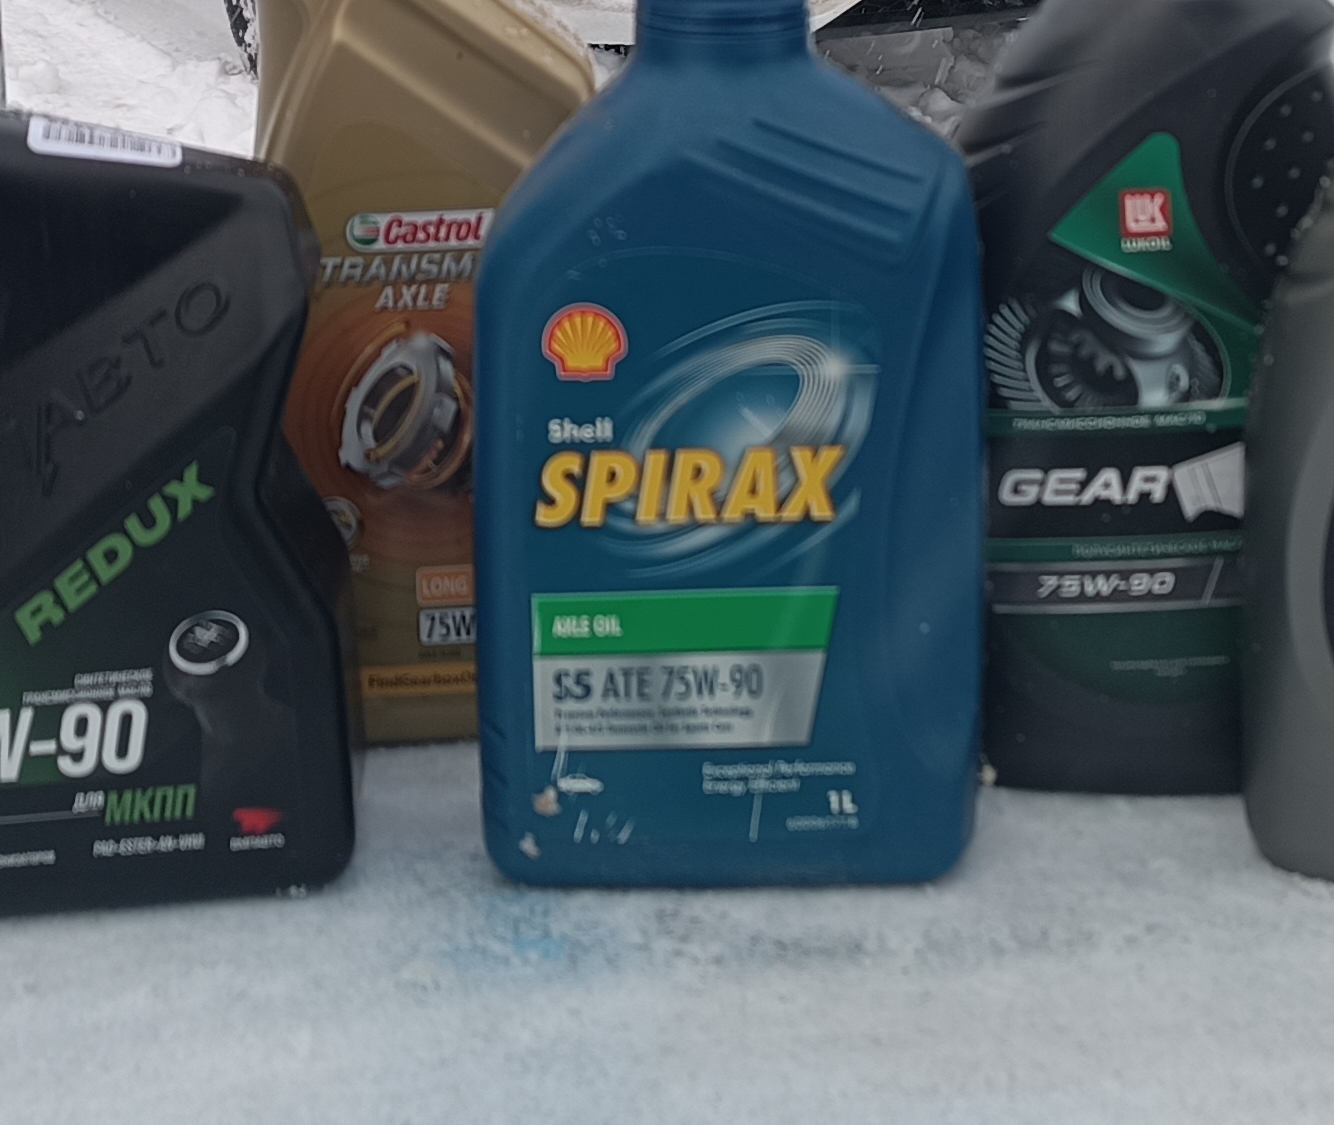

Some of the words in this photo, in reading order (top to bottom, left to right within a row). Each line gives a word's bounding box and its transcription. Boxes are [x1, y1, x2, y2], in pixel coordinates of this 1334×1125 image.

[383, 211, 483, 245] Castrol
[320, 252, 478, 283] TRANSM
[374, 283, 450, 311] AXLE
[547, 416, 613, 443] Shell
[535, 445, 845, 528] SPIRAX
[998, 465, 1172, 506] GEAR
[14, 460, 216, 646] REDUX
[422, 576, 468, 597] LONG
[1036, 572, 1176, 598] 75W-90
[552, 615, 591, 638] AXLE
[593, 614, 623, 637] OIL
[601, 664, 652, 702] ATE
[660, 663, 765, 701] 75W-90
[104, 783, 197, 825] МКПП
